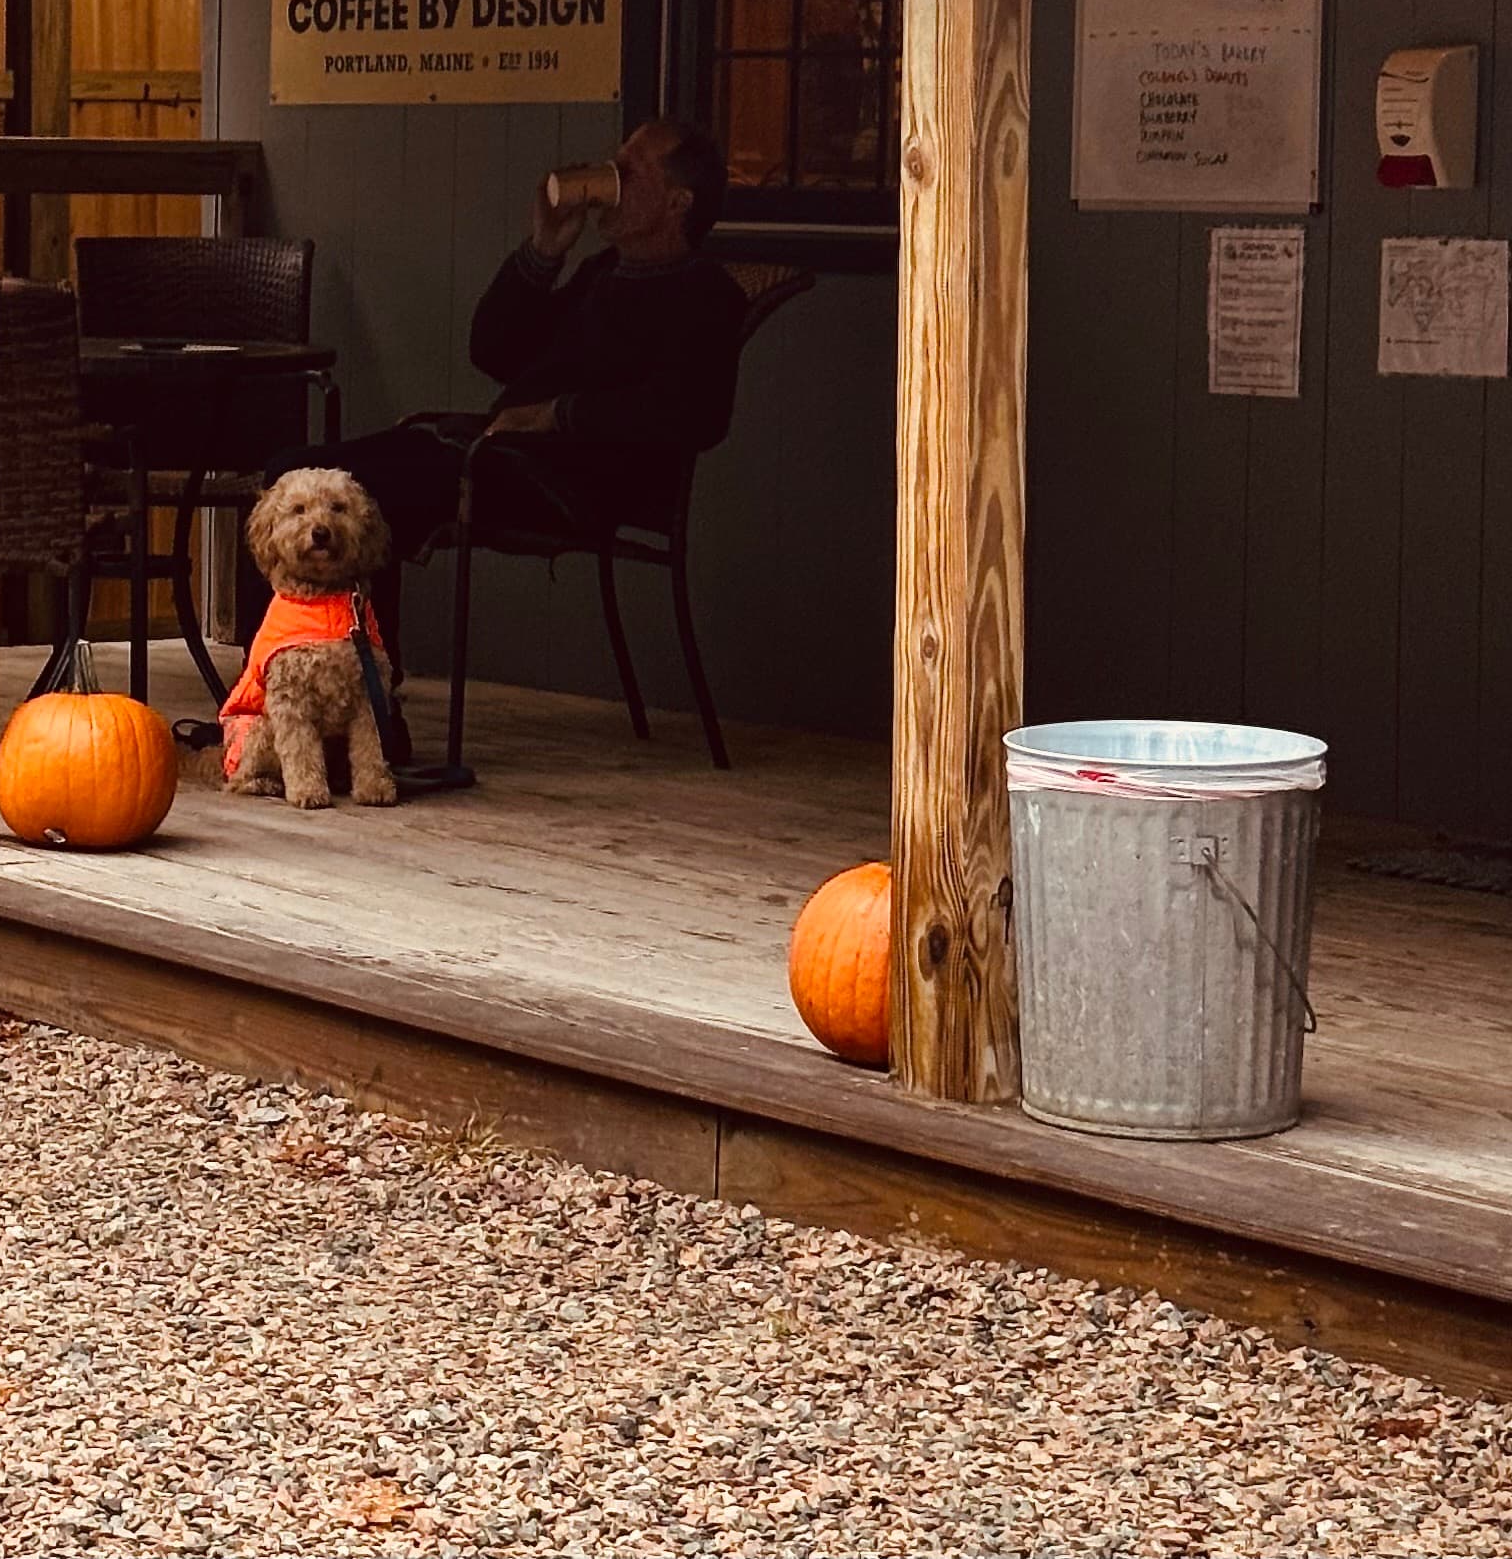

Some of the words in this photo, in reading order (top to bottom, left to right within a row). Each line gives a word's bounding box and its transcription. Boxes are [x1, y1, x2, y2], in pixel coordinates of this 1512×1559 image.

[324, 53, 412, 75] PORTLAND,
[420, 52, 474, 73] MAINE
[528, 50, 559, 71] 1994
